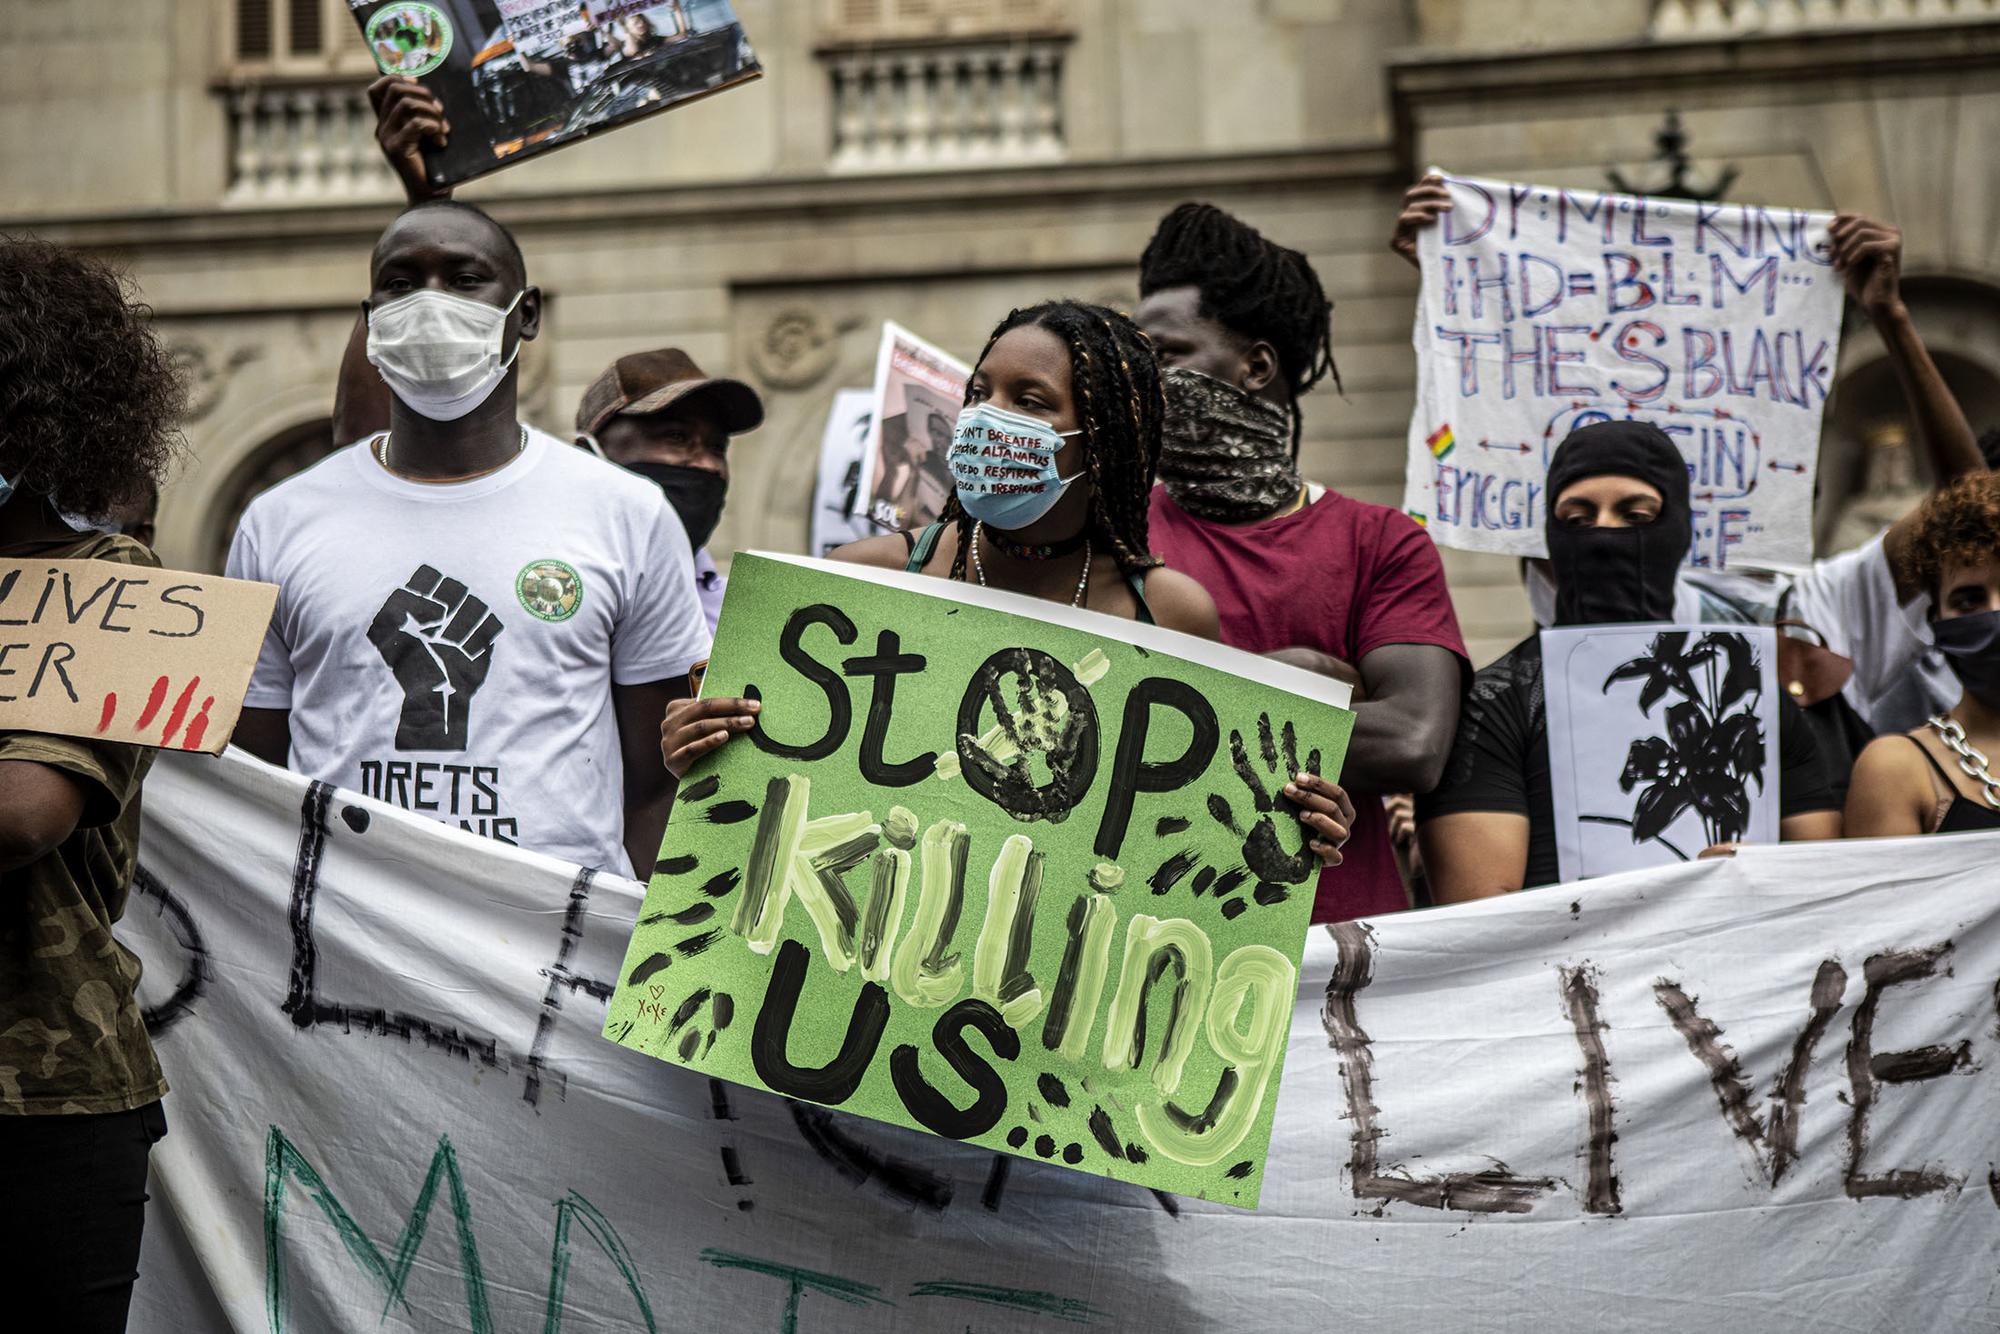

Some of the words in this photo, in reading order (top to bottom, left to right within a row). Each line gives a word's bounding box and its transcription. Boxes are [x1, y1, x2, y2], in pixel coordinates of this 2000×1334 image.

[980, 484, 987, 493] A
[360, 760, 498, 816] DRETS
[1320, 920, 2000, 1217] LIVE
